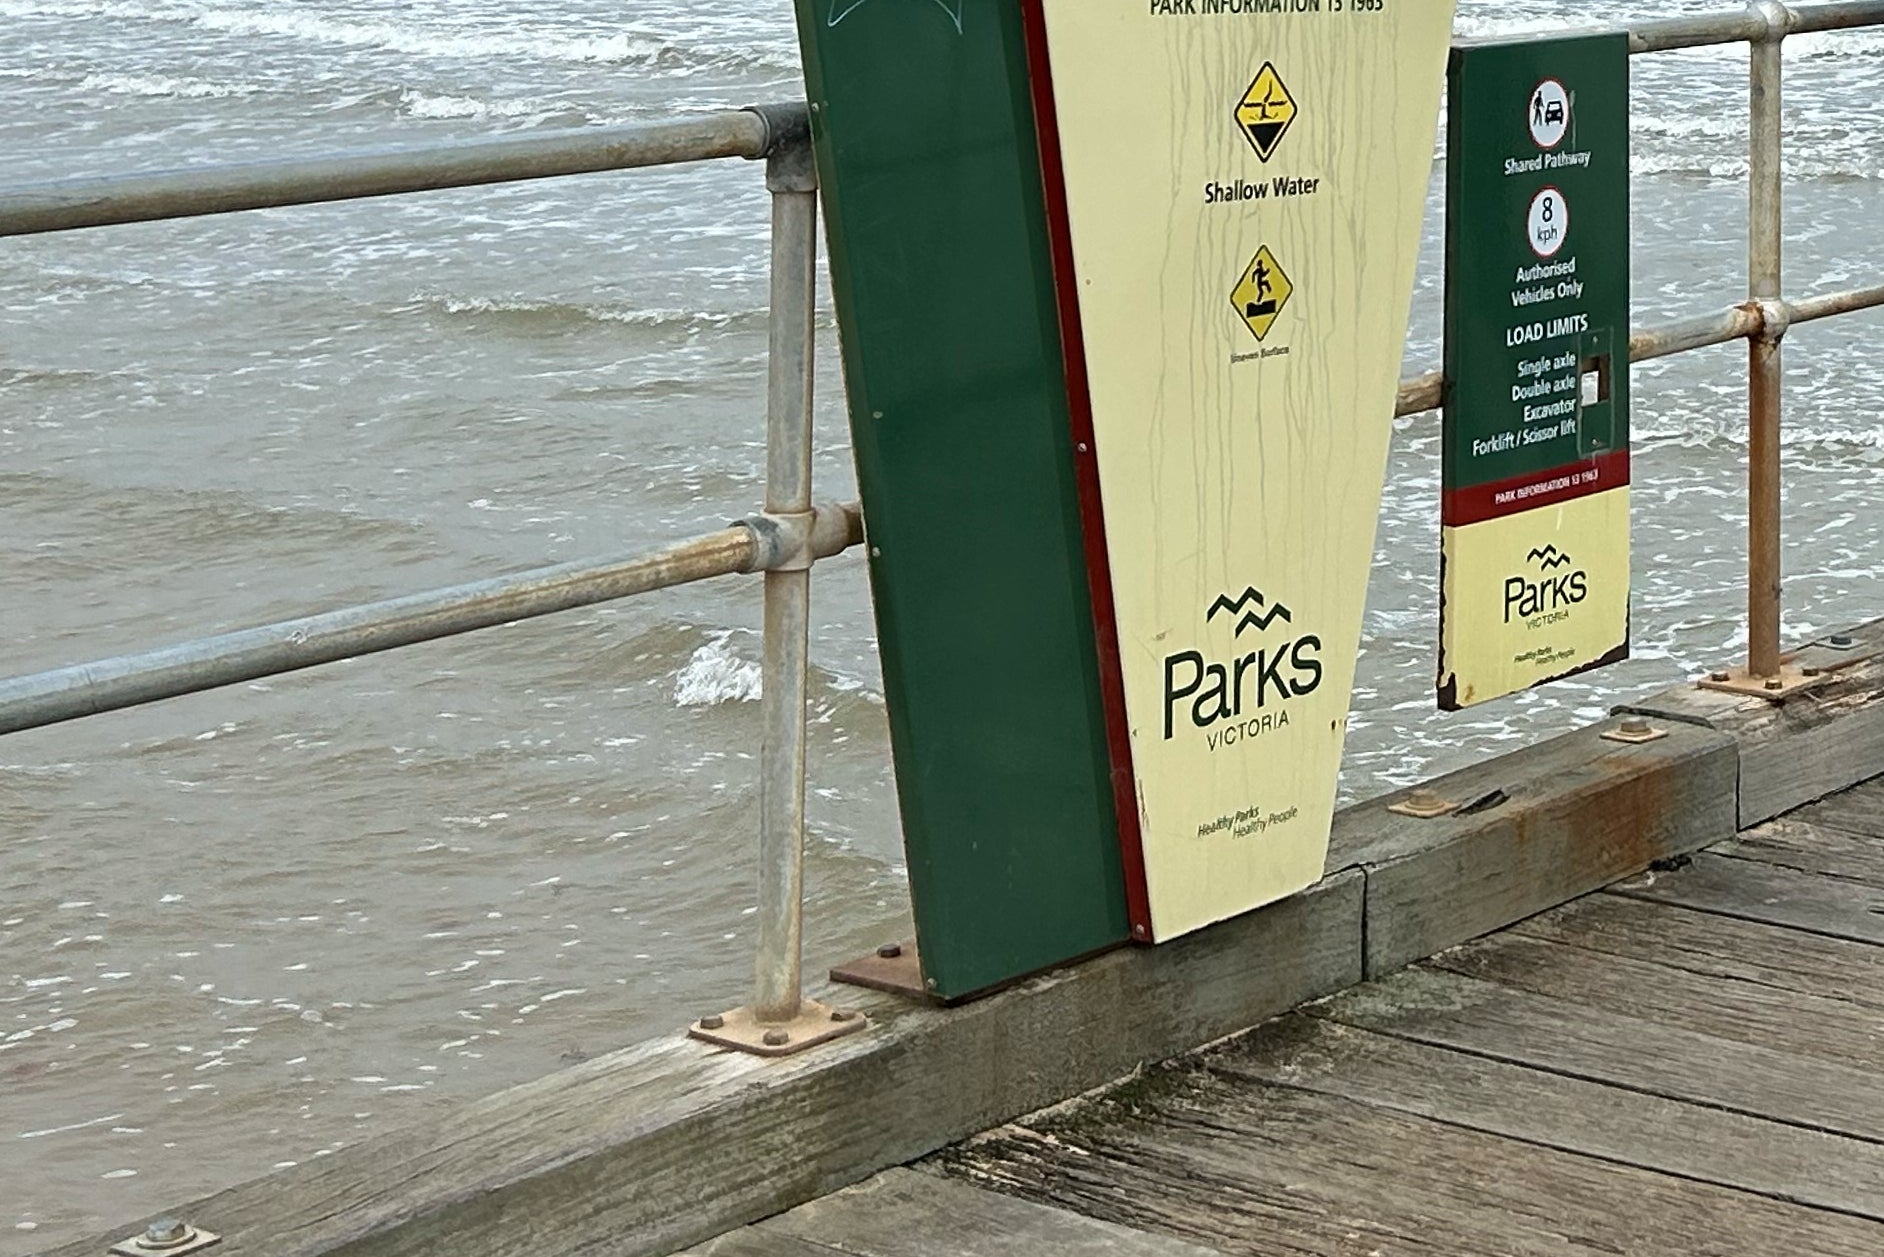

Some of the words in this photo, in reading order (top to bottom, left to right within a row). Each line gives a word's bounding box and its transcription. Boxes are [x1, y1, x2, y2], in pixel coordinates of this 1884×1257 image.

[1504, 153, 1543, 175] Shared
[1545, 151, 1591, 168] Pathway
[1205, 179, 1268, 204] Shallow
[1273, 176, 1319, 197] Water
[1542, 197, 1553, 222] 8
[1537, 225, 1557, 245] kph
[1516, 256, 1576, 283] Authorised
[1511, 285, 1555, 307] Vehicles
[1557, 278, 1584, 299] Only
[1506, 323, 1544, 346] LOAD
[1546, 313, 1588, 339] LIMITS
[1518, 356, 1551, 377] Single
[1553, 351, 1576, 370] axle
[1511, 379, 1551, 401] Double
[1553, 373, 1576, 392] axle
[1523, 398, 1576, 422] Excavator
[1472, 431, 1515, 457] Forklift
[1522, 425, 1559, 444] Scissor
[1560, 418, 1576, 436] lift
[1495, 490, 1517, 504] PARK
[1504, 570, 1587, 624] Parks
[1163, 634, 1323, 740] Parks
[1206, 709, 1289, 752] VICTORIA
